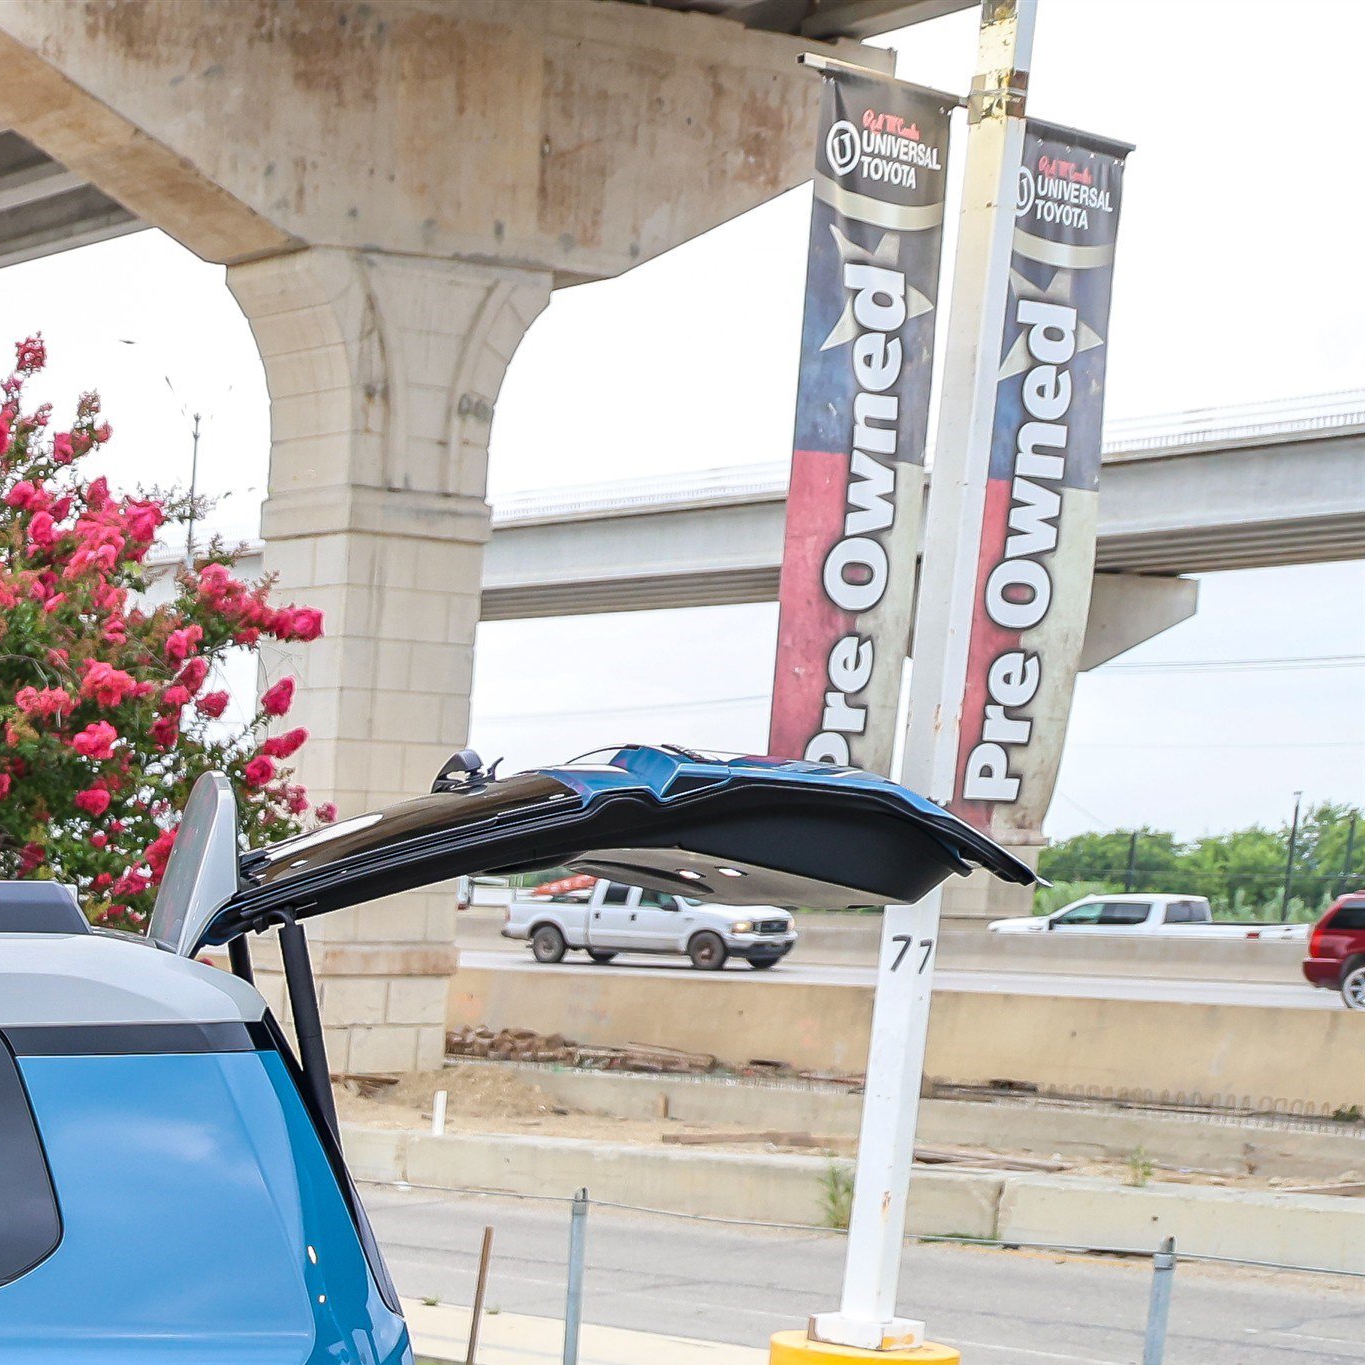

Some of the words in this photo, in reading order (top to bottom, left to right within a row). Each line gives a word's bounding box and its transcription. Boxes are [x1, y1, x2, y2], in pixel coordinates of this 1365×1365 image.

[862, 130, 942, 171] UNIVERSAL
[860, 155, 916, 190] TOYOTA
[1037, 175, 1113, 212] UNIVERSAL
[1035, 199, 1089, 230] TOYOTA
[823, 262, 906, 612] Owned
[985, 300, 1077, 629] Owned
[963, 651, 1040, 802] Pre
[890, 934, 933, 975] 77
